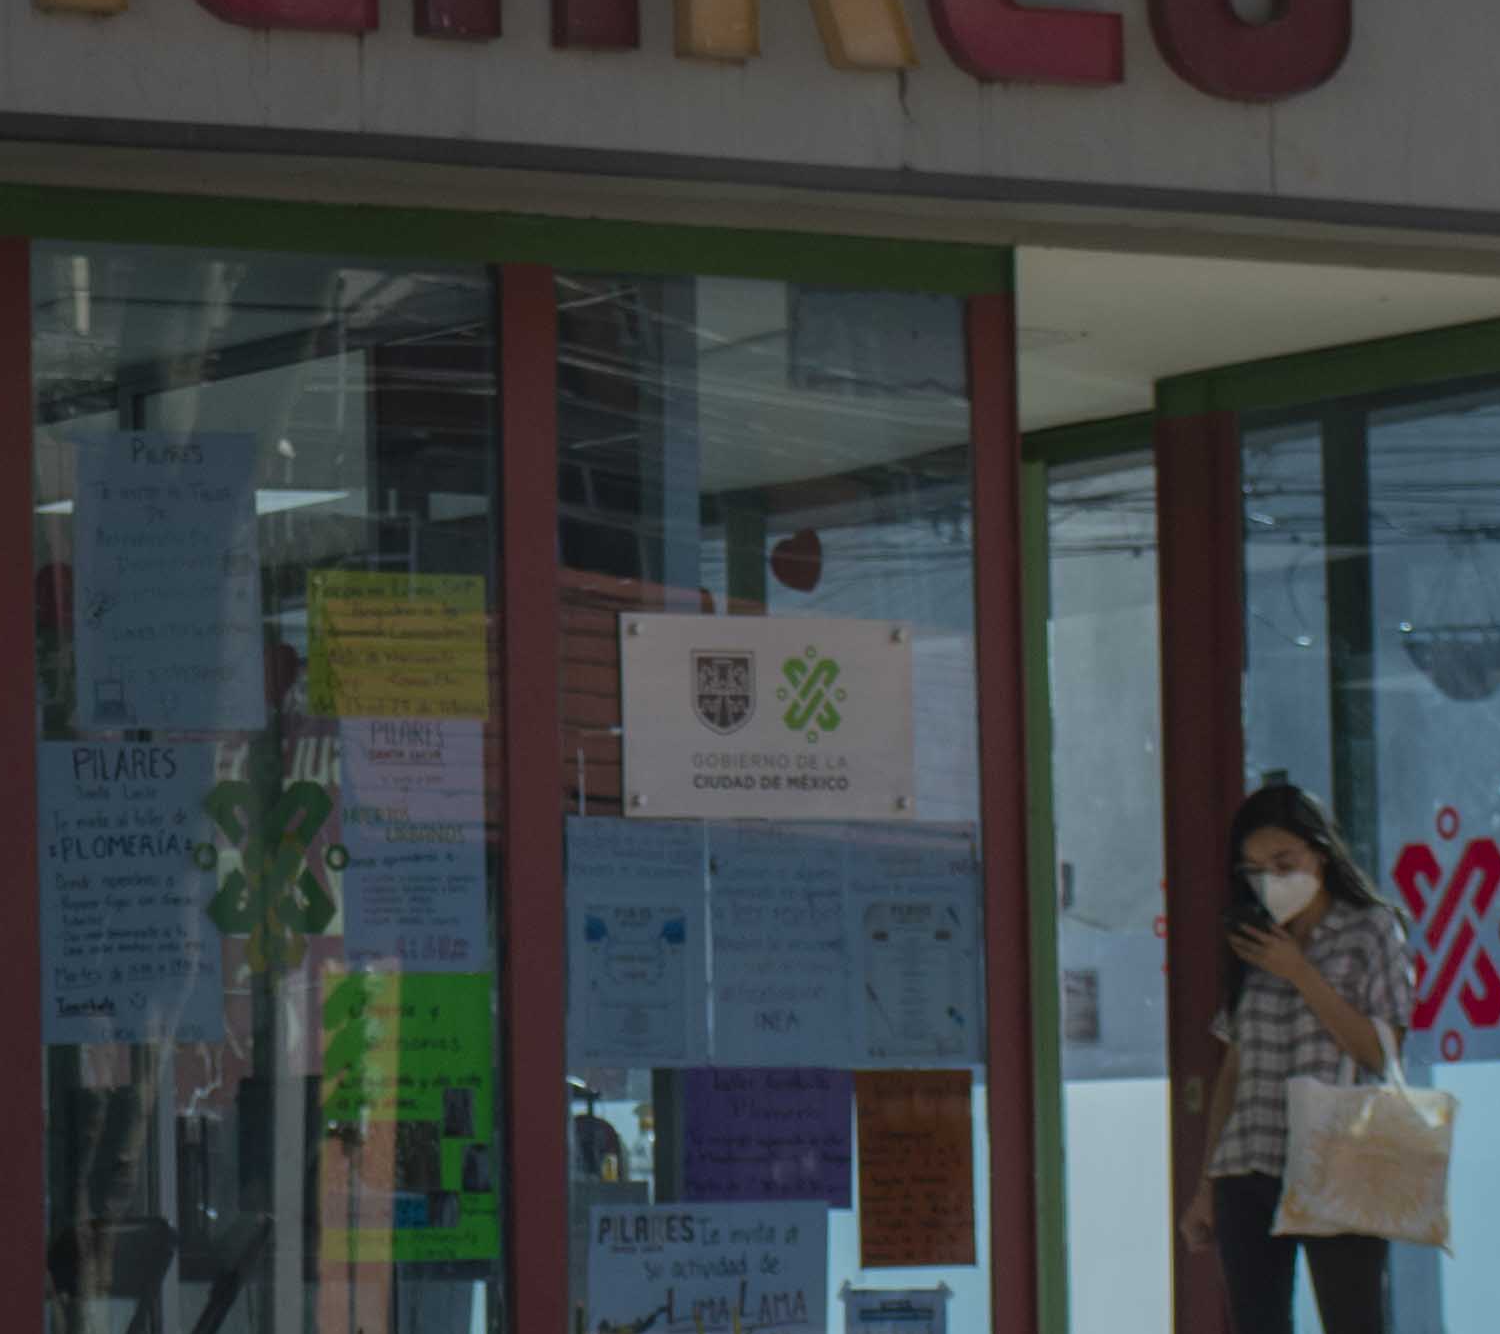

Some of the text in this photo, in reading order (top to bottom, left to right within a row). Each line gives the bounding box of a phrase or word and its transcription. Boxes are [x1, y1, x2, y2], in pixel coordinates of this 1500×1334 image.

[371, 722, 445, 749] PILARES
[72, 747, 178, 782] PILARES
[691, 753, 849, 770] GOBIERNO DE LA
[692, 774, 757, 790] CIUDAD
[759, 774, 785, 790] DE
